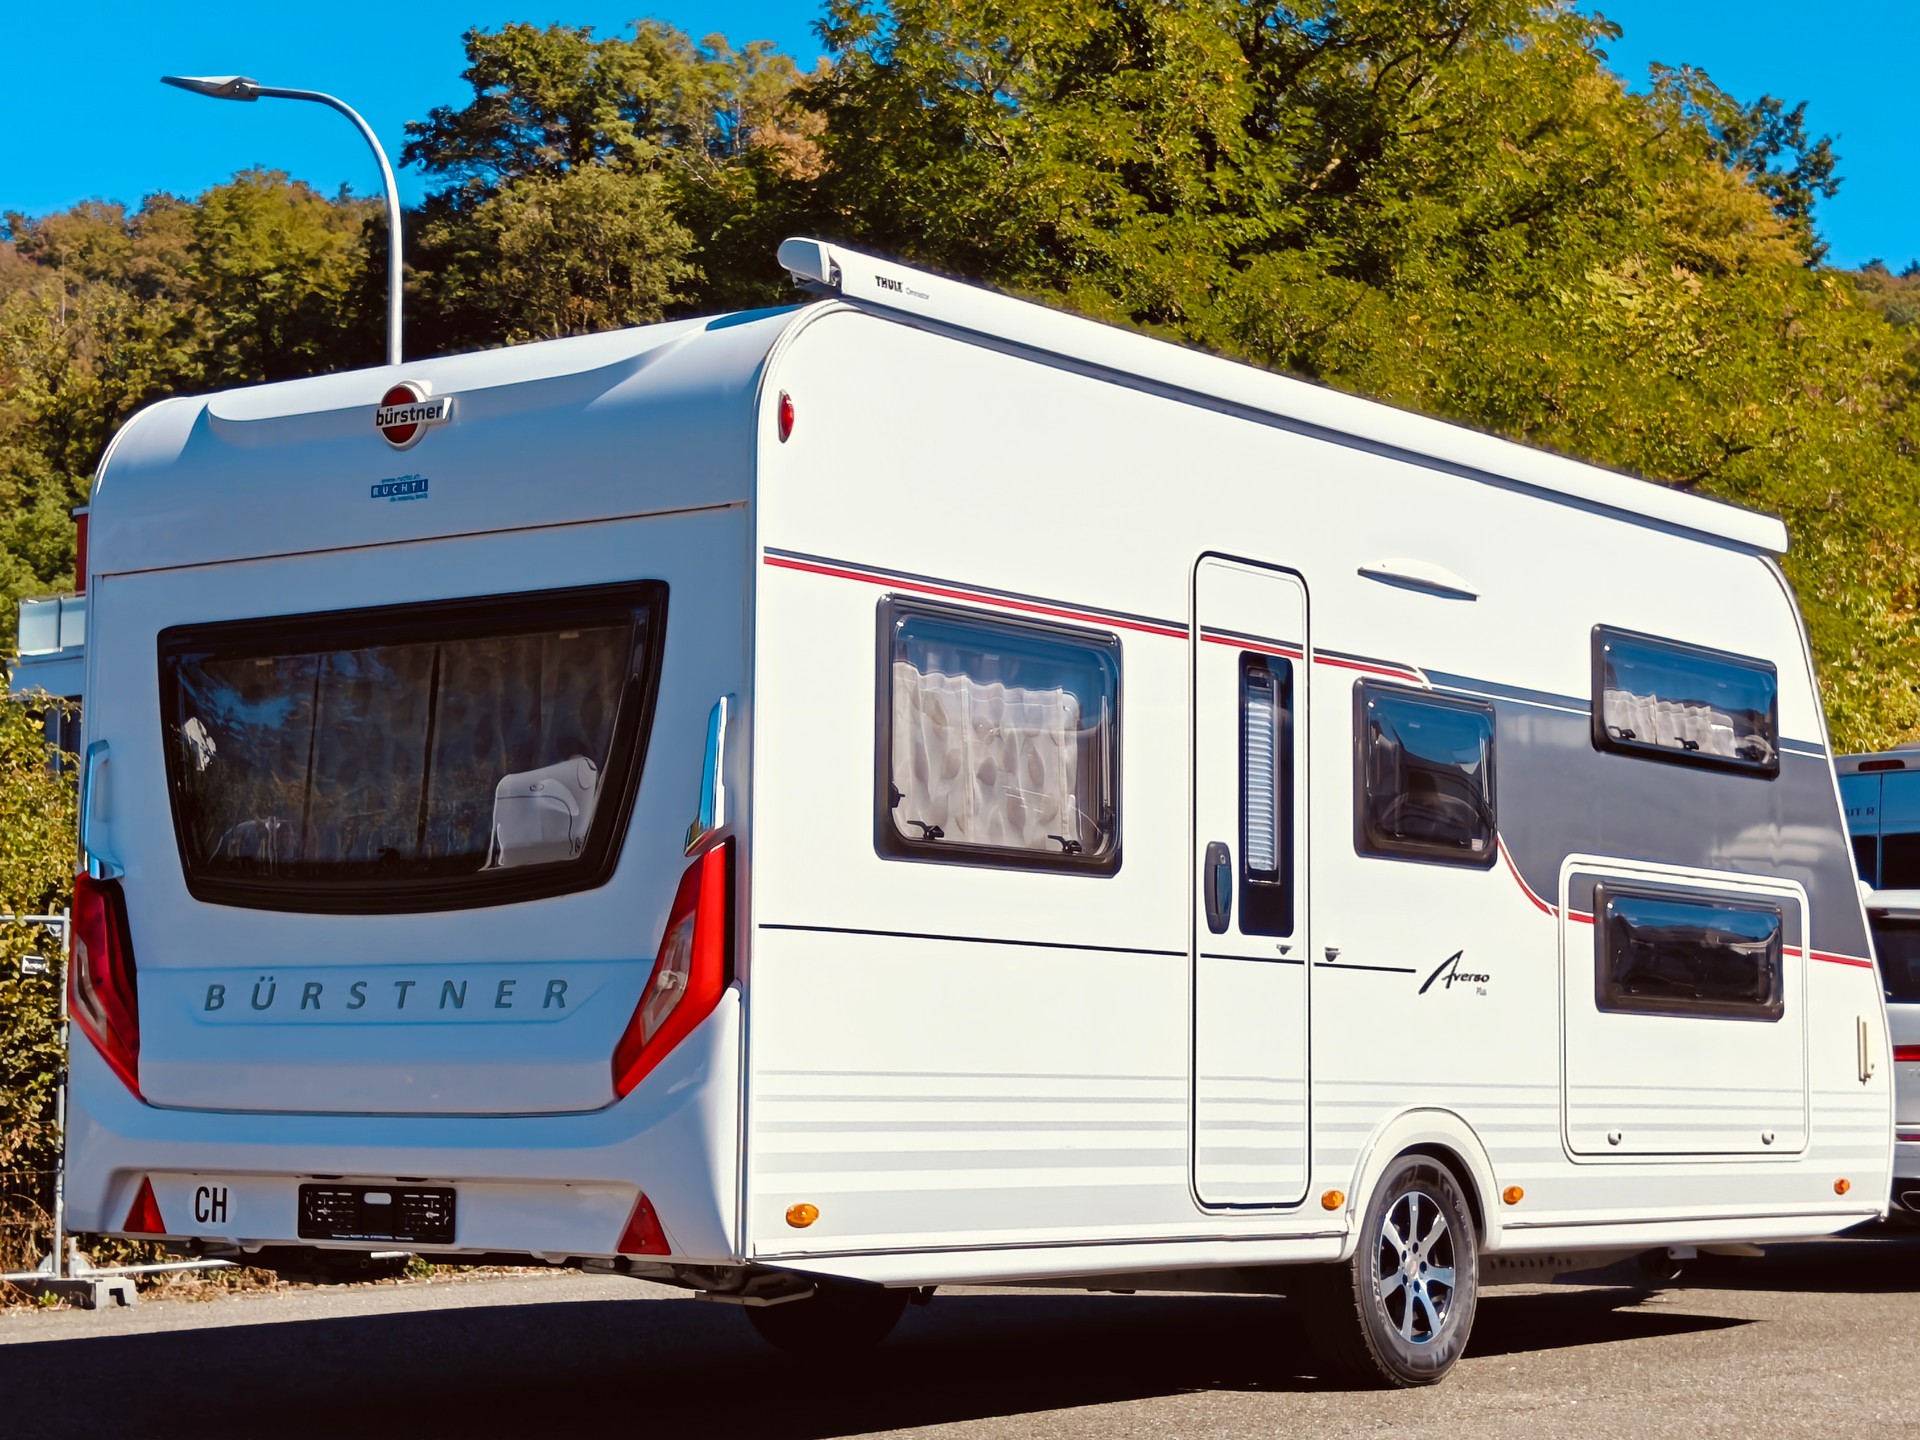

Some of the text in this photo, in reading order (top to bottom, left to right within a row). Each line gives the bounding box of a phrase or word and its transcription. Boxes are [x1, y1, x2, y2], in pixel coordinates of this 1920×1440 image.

[875, 275, 903, 293] THULE
[376, 405, 443, 426] bürstner
[372, 481, 425, 496] RUCHTI
[1418, 949, 1490, 995] Averso
[203, 976, 568, 1011] BÜRSTNER
[194, 1186, 228, 1223] CH
